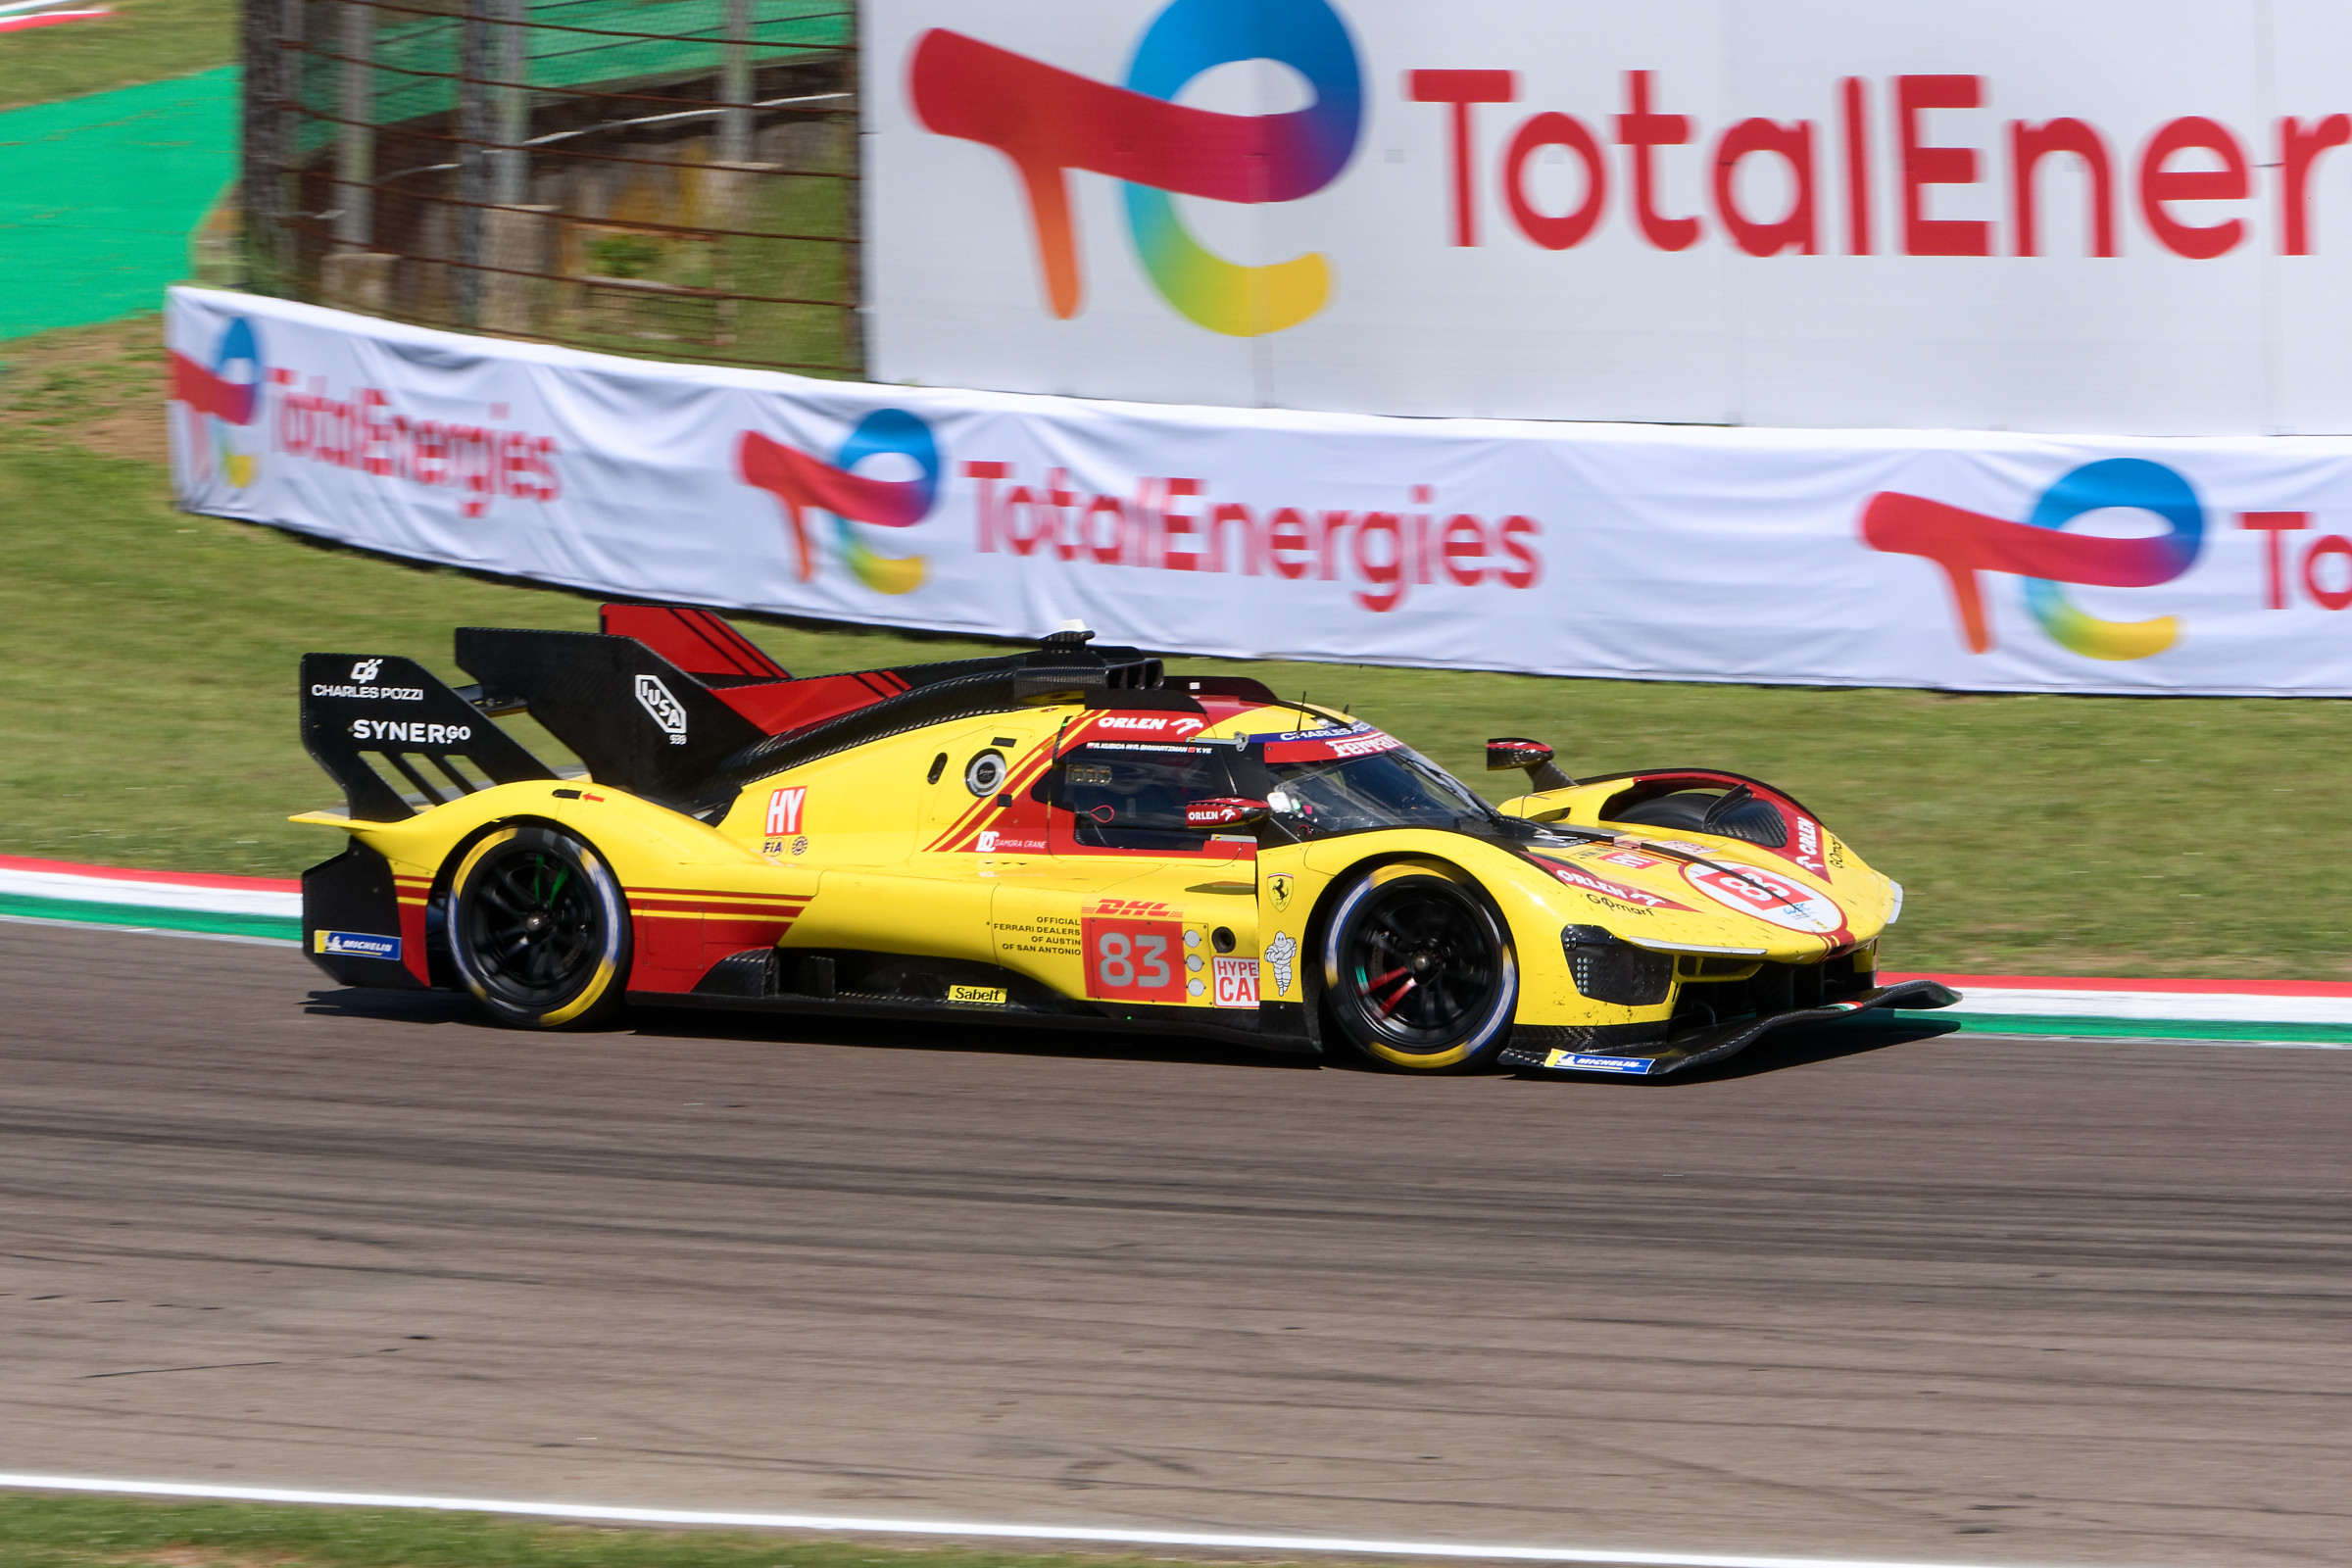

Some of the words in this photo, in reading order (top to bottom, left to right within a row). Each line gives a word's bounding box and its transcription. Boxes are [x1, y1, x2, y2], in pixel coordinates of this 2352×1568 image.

[1405, 69, 2352, 259] TotalEner
[267, 367, 561, 517] TotalEnergies
[962, 462, 1542, 612] TotalEnergies
[2237, 511, 2352, 612] To
[311, 684, 380, 699] CHARLES
[380, 687, 424, 701] POZZI
[1098, 717, 1168, 730] ORLEN
[1280, 728, 1352, 741] CHARLES
[765, 788, 807, 834] HY
[1188, 809, 1219, 821] ORLEN
[1797, 816, 1818, 856] ORLEN
[1024, 840, 1047, 849] CRANE
[1605, 853, 1651, 869] HY
[1556, 869, 1628, 900] ORLEN
[1719, 872, 1790, 902] 83
[1095, 899, 1170, 917] DHL
[1036, 916, 1080, 925] OFFICIAL
[994, 923, 1035, 932] FERRARI
[1036, 926, 1081, 936] DEALERS
[343, 940, 393, 953] MICHELIN
[1046, 937, 1081, 946] AUSTIN
[1038, 947, 1081, 956] ANTONIO
[1099, 932, 1171, 988] 83
[1217, 960, 1259, 976] HYPE
[956, 987, 1000, 1002] Sabelt
[1576, 1058, 1640, 1068] MICHELIN
